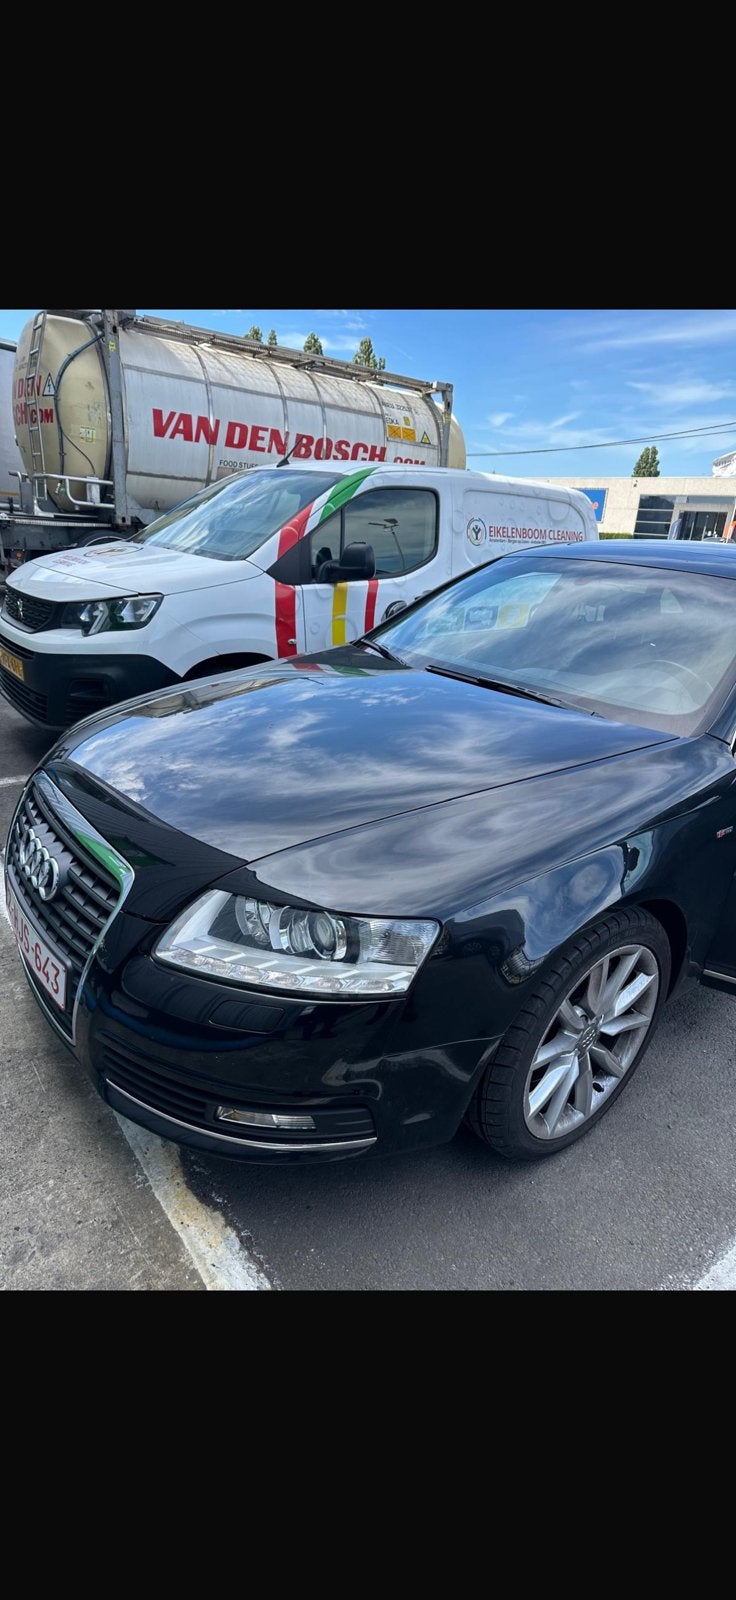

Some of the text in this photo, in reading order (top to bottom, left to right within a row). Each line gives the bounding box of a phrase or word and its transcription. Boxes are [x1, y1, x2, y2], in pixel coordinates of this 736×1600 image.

[152, 408, 387, 462] VAN DEN BOSCH
[219, 459, 238, 468] FOOD
[488, 525, 547, 540] EIKELENBOOM
[548, 529, 583, 542] CLEANING
